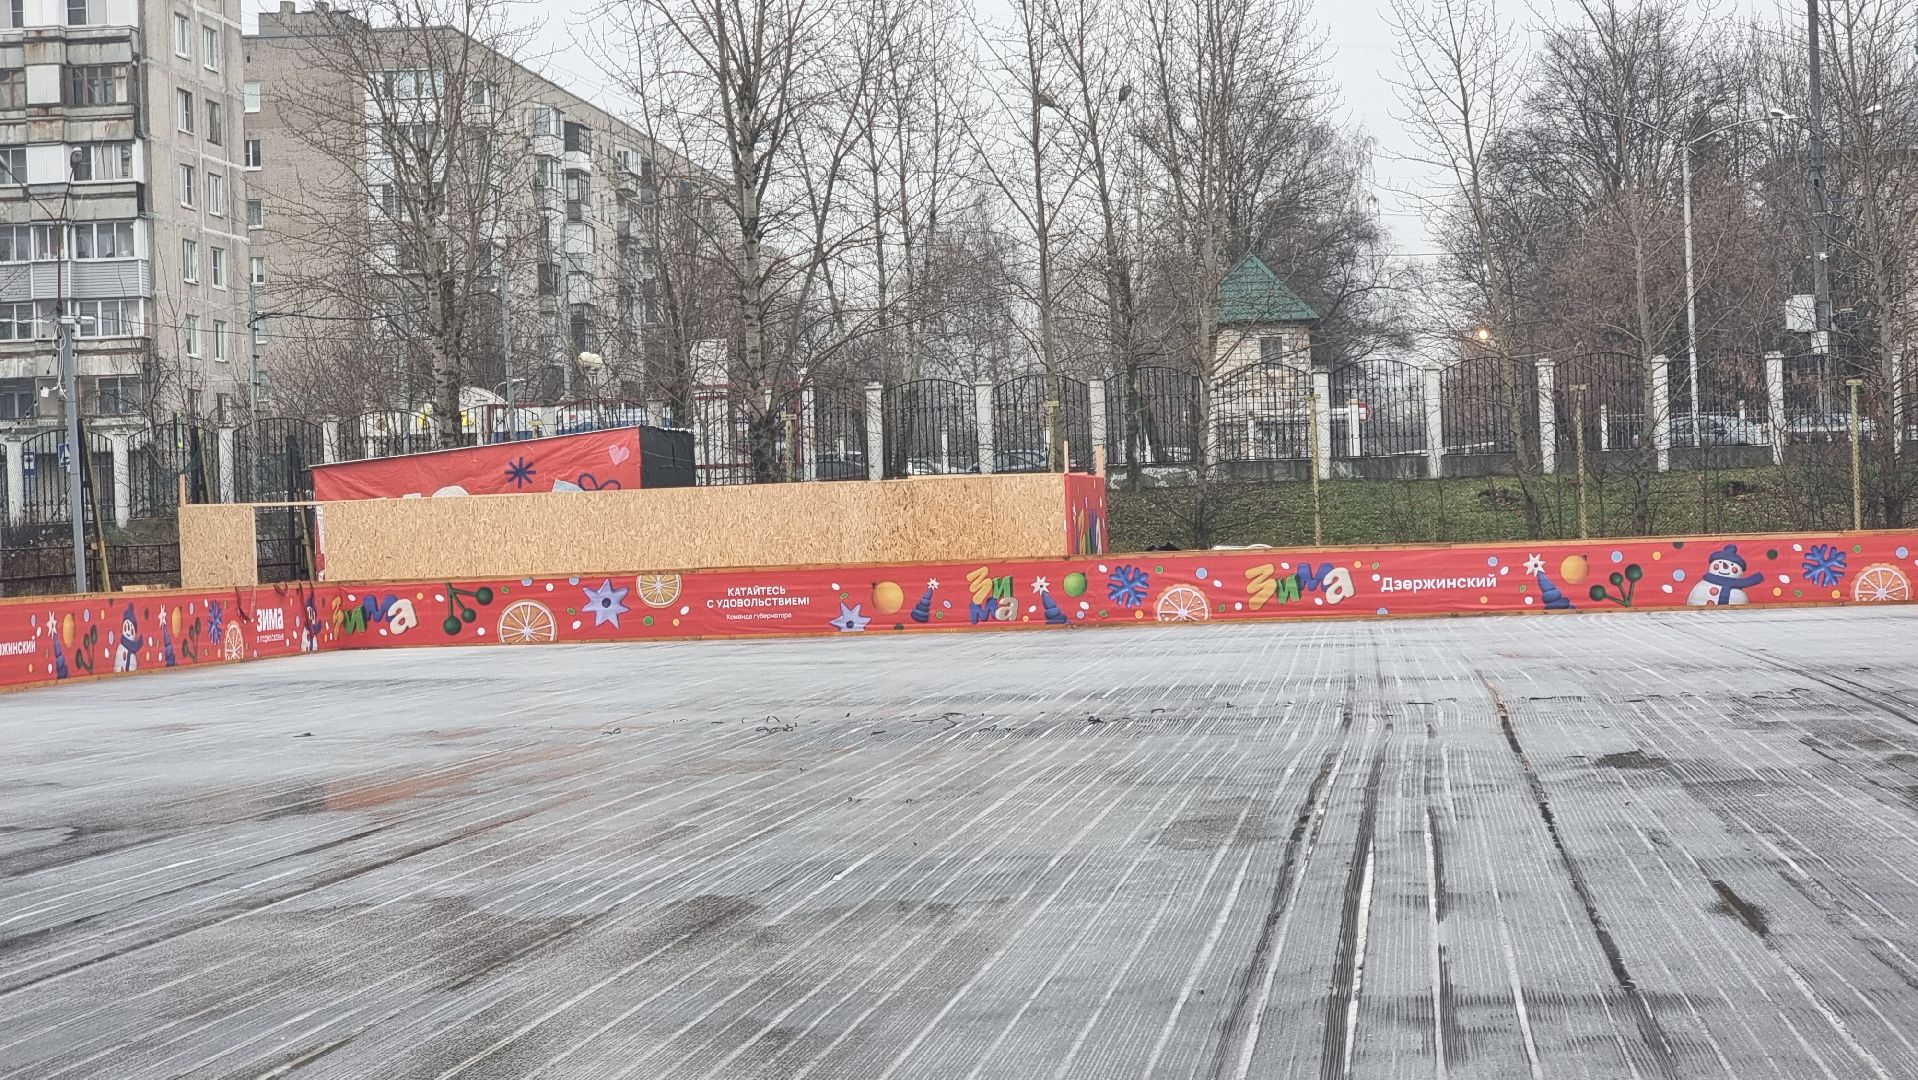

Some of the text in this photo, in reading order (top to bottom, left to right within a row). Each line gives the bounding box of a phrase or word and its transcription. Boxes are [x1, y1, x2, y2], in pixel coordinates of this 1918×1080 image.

[1380, 573, 1497, 594] Дзержинский
[727, 585, 786, 597] КАТАЙТЕСЬ
[706, 597, 810, 609] С УДОВОЛЬСТВИЕМ!
[726, 612, 792, 621] Команда губернатора
